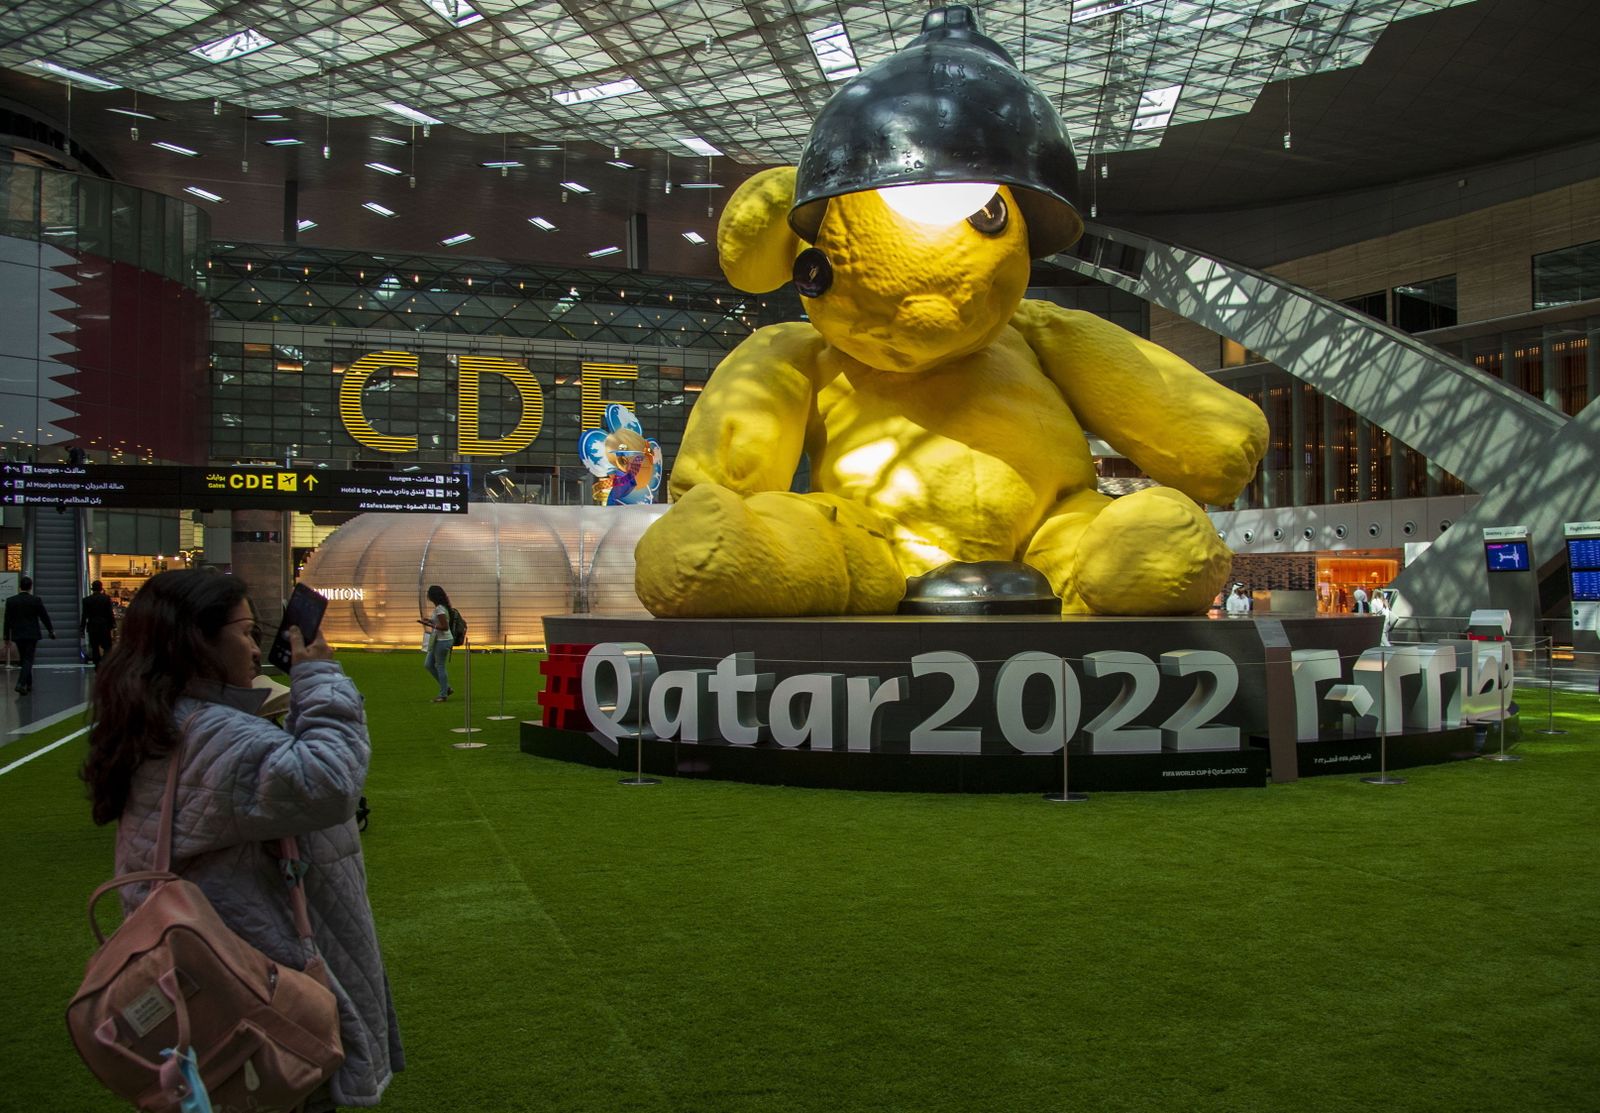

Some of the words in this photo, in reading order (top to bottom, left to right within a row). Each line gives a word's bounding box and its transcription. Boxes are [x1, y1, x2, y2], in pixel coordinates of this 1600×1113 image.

[34, 467, 60, 475] Lounges
[229, 474, 274, 489] CDE
[58, 482, 80, 490] Lounge
